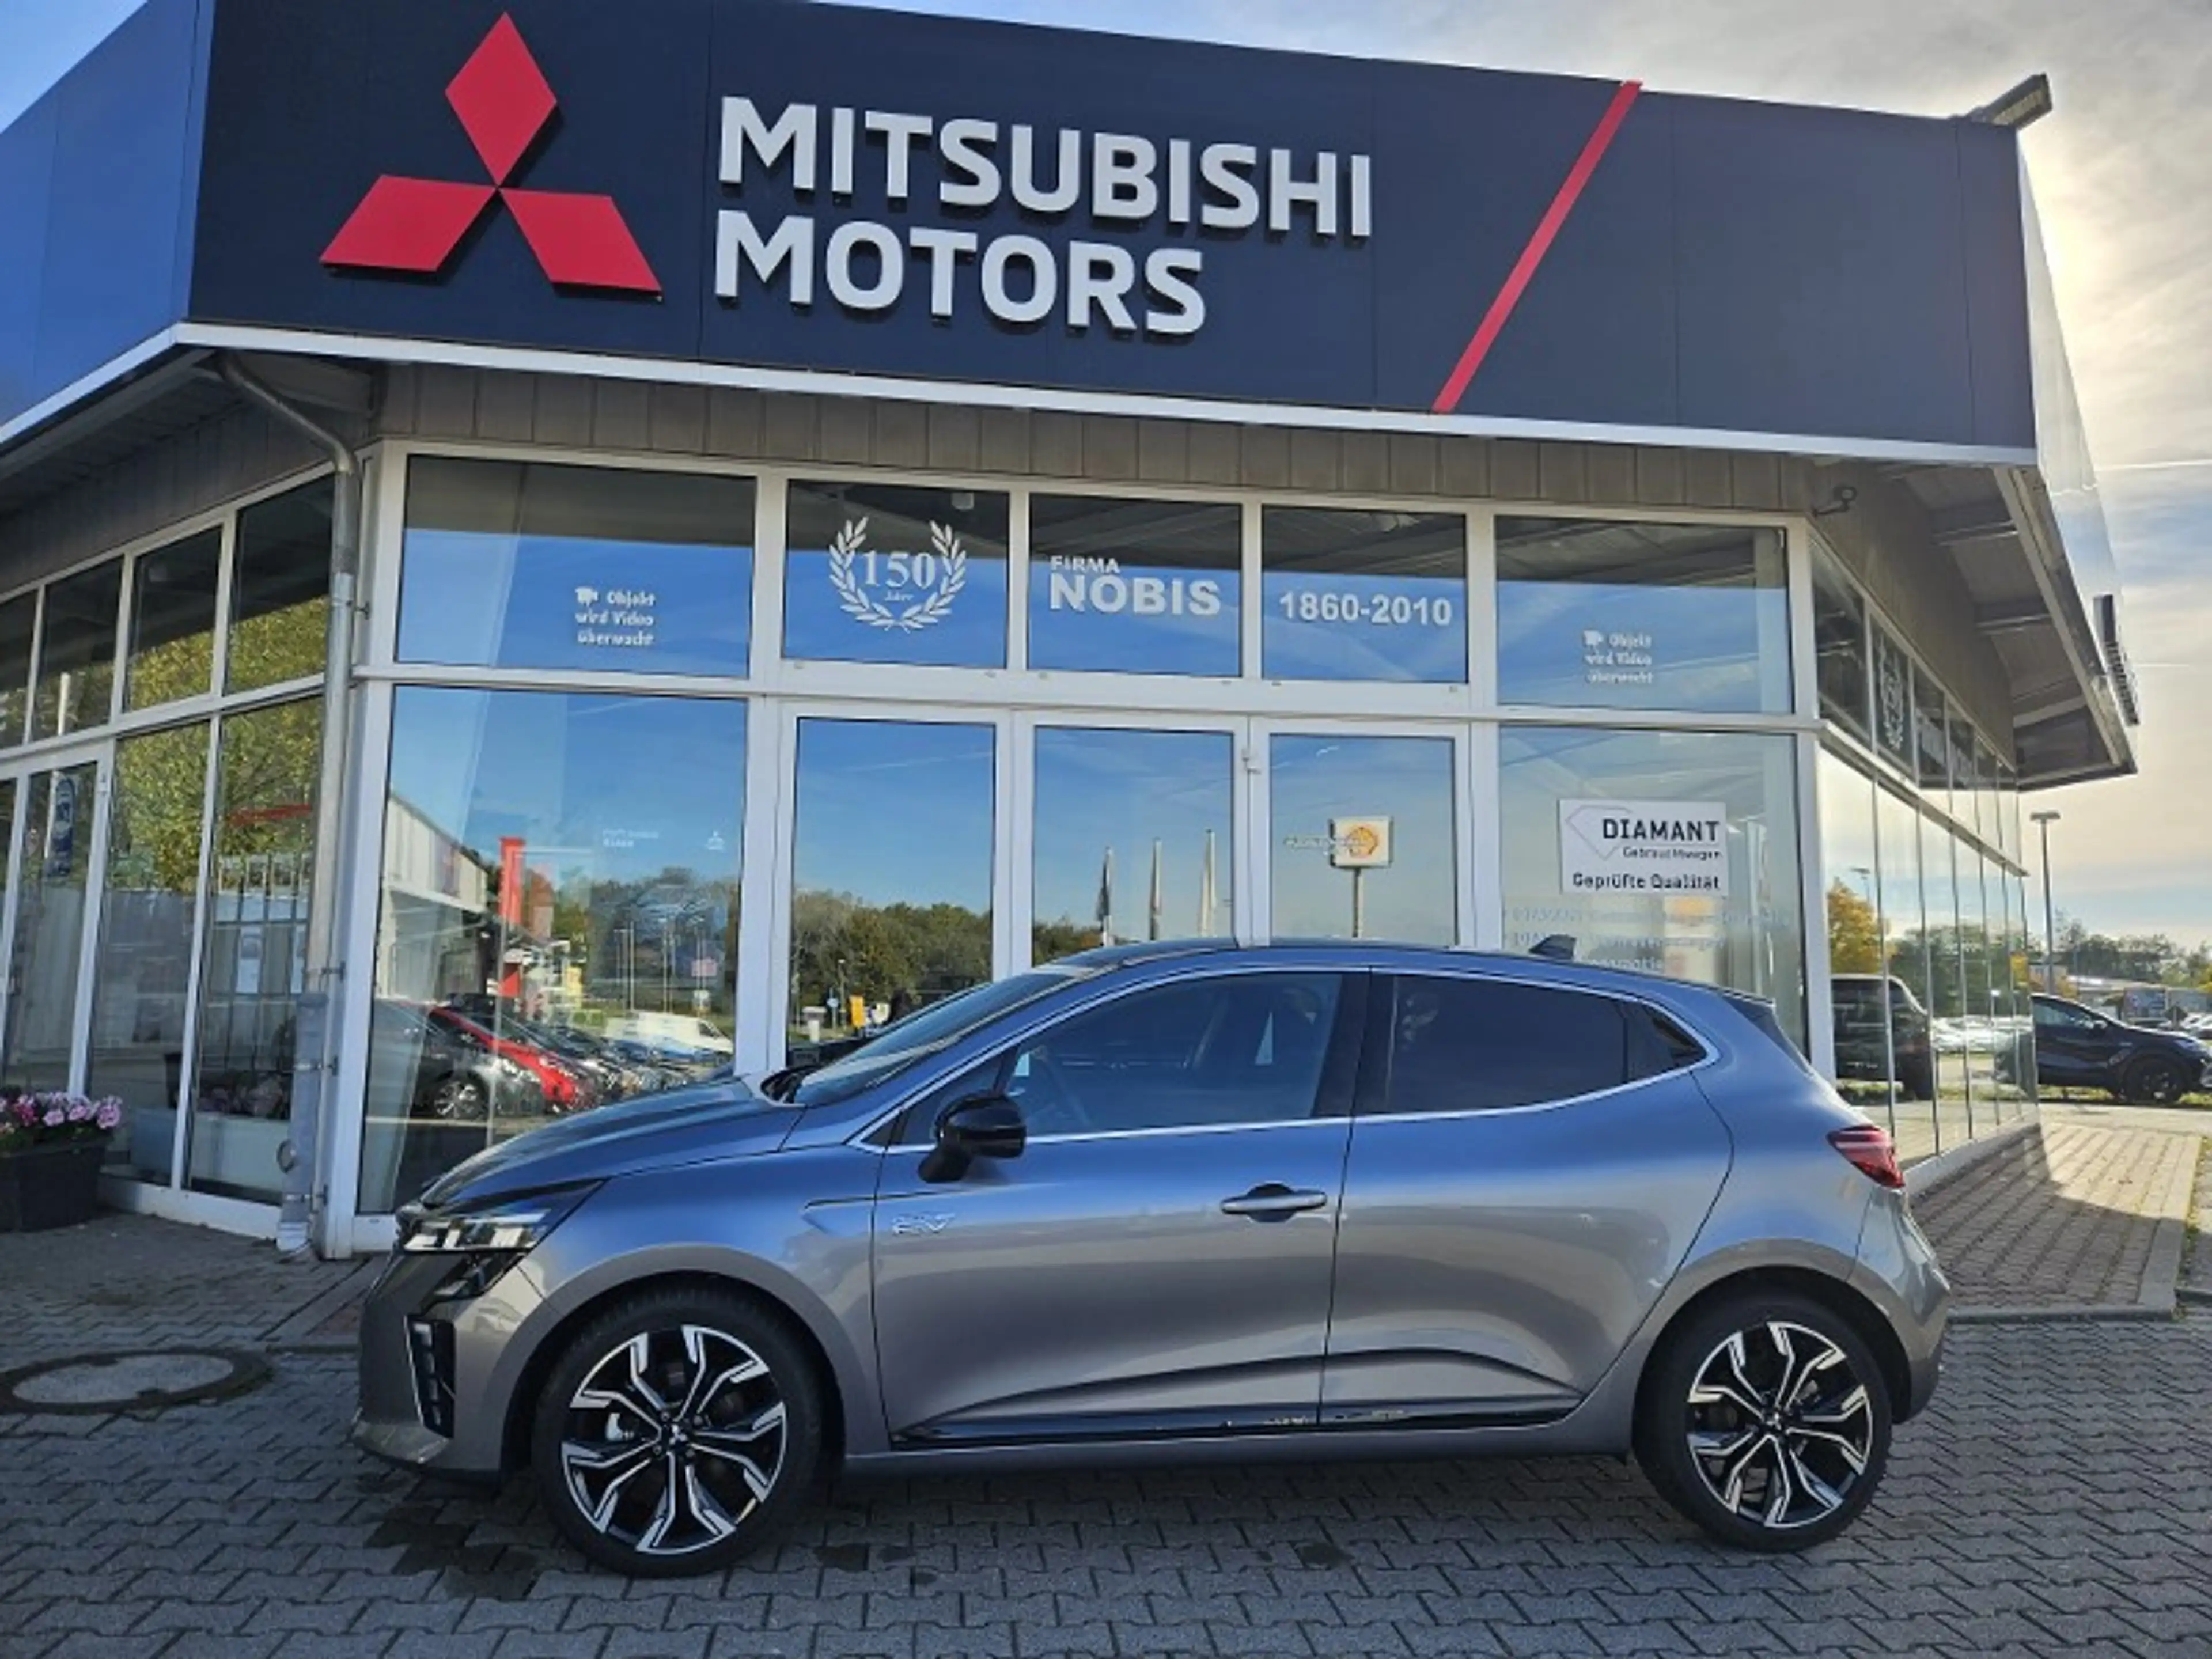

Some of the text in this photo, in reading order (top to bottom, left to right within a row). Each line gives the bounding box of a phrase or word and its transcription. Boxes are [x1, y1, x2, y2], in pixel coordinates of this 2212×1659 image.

[719, 95, 1372, 237] MITSUBISHI
[715, 209, 1206, 334] MOTORS
[863, 550, 935, 589] 150
[1050, 573, 1221, 615] NOBIS
[1279, 592, 1452, 626] 1860-2010
[1603, 818, 1720, 842] DIAMANT
[1572, 871, 1721, 891] Geprüfte Qualität
